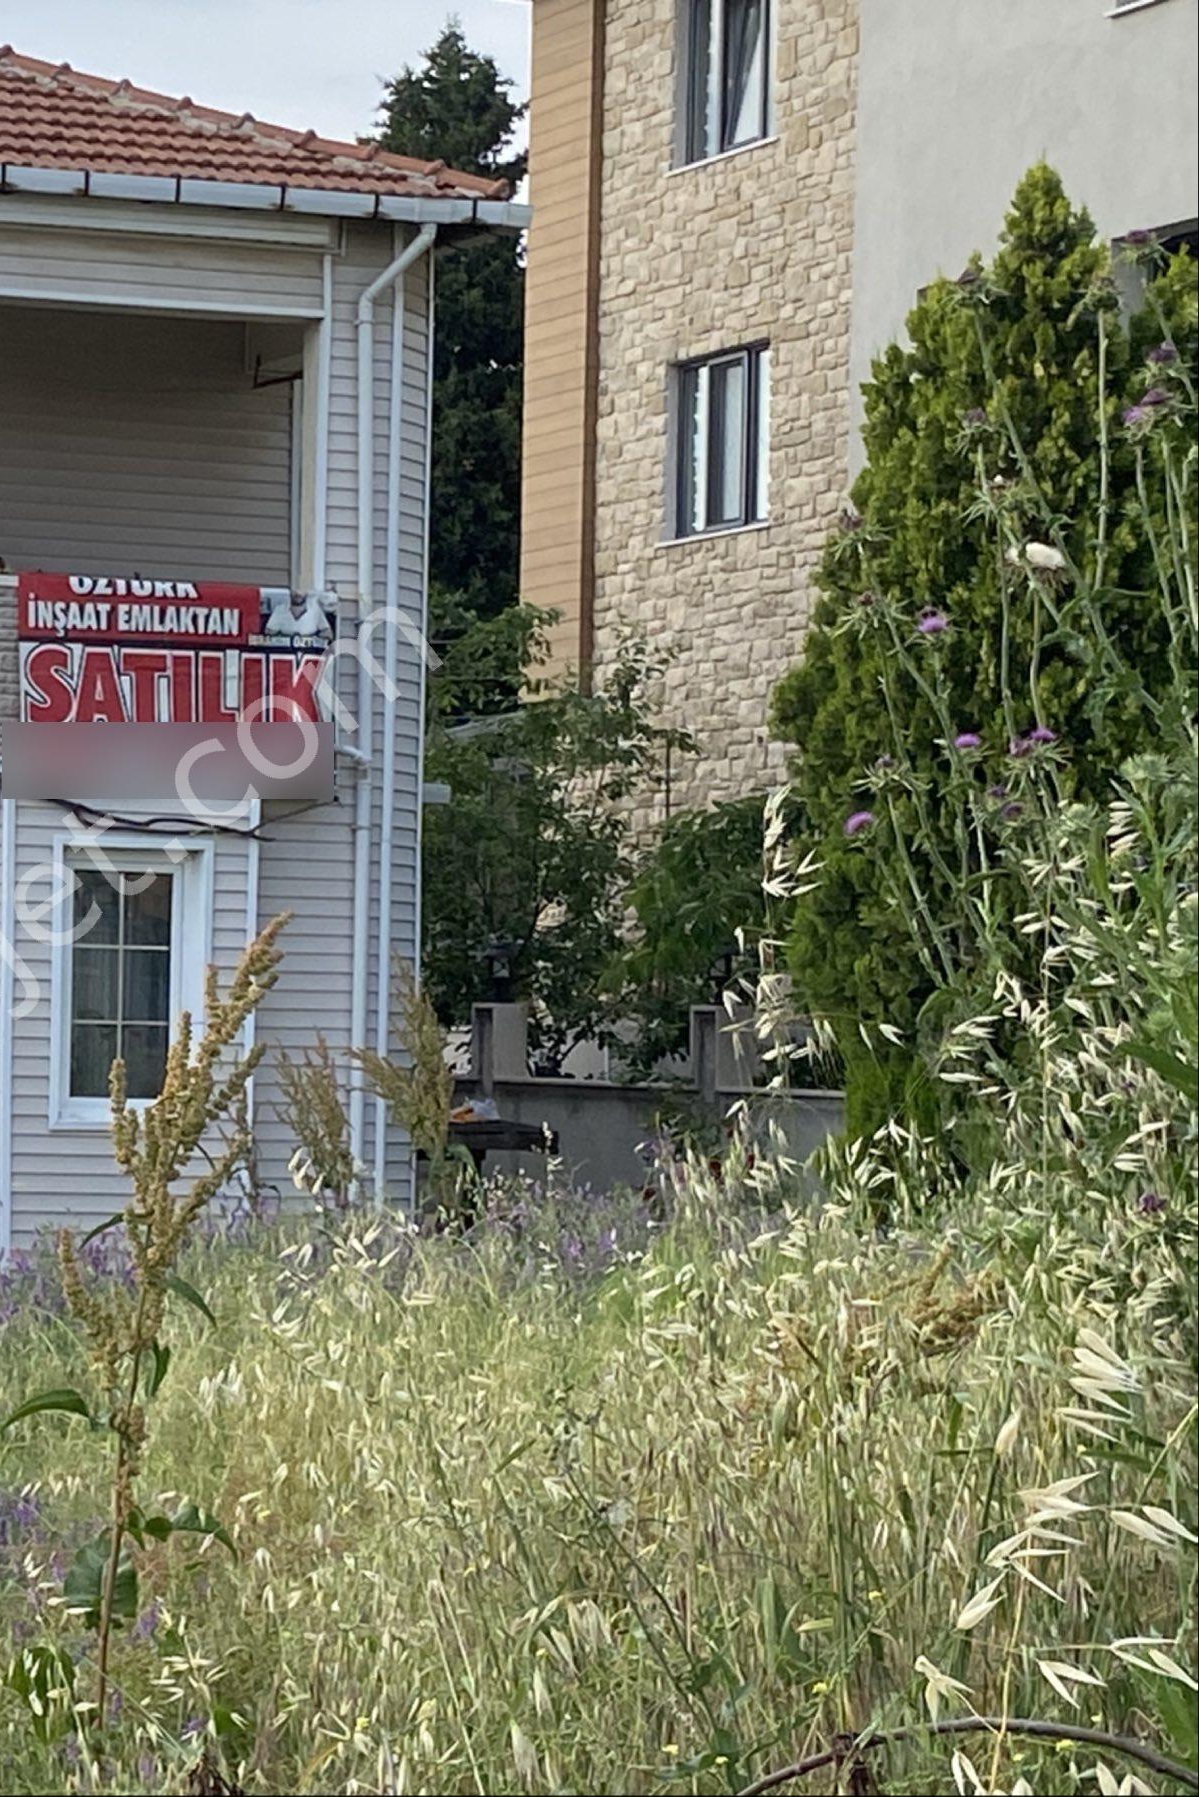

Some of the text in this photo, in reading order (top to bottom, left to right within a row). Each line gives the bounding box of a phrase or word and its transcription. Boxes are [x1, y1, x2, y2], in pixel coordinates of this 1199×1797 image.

[28, 594, 240, 636] İNŞAAT EMLAKTAN
[24, 644, 330, 722] SATILIK
